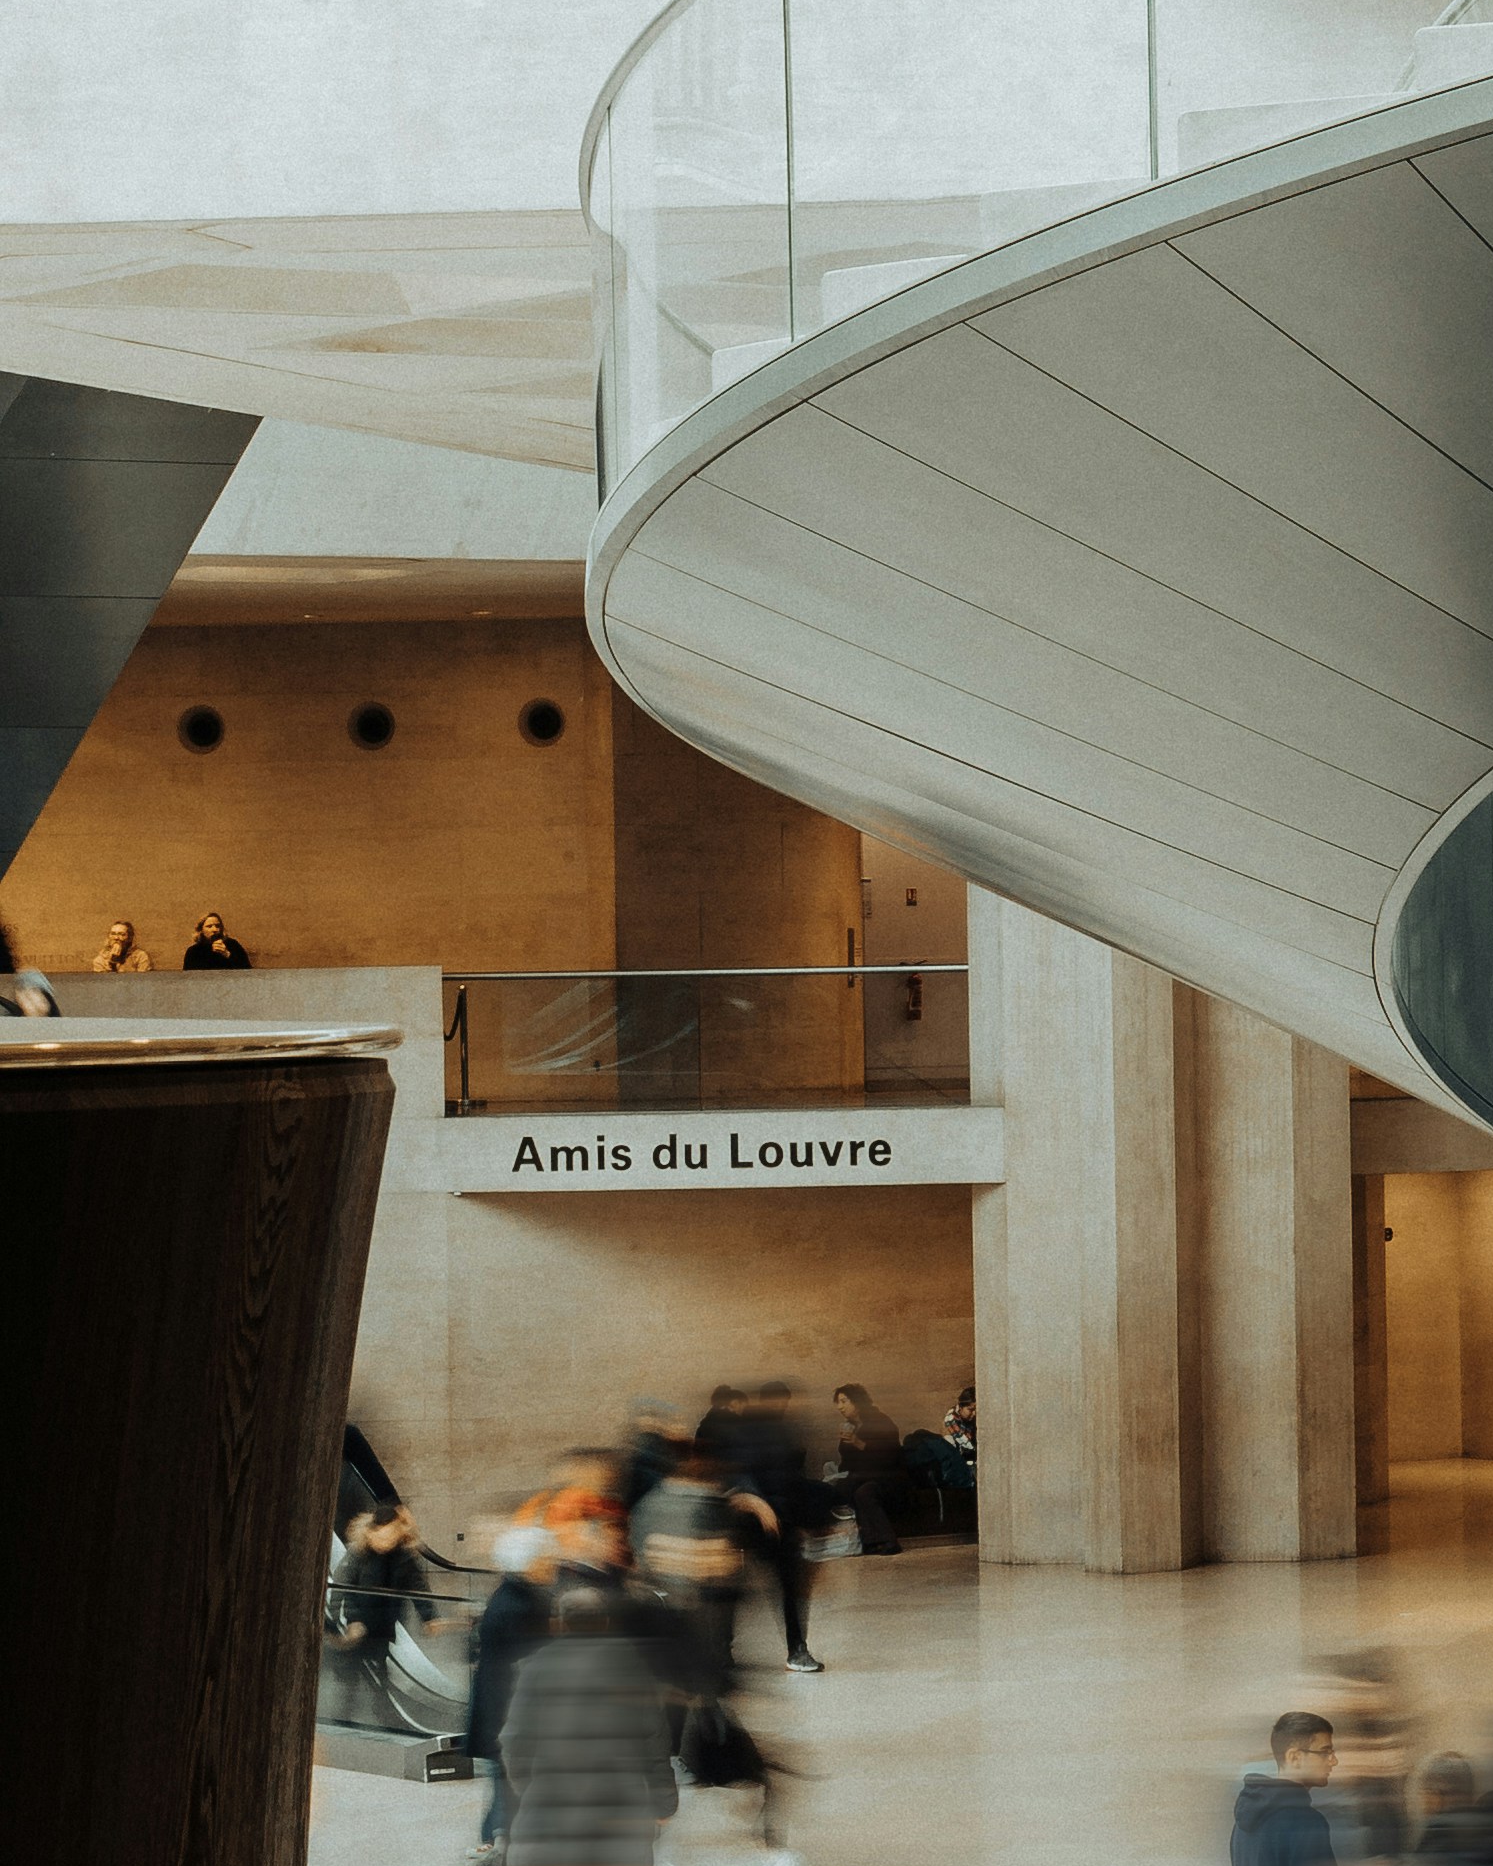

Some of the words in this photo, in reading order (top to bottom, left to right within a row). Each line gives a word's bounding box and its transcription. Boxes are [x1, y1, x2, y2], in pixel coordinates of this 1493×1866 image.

[511, 1134, 633, 1173] Amis
[652, 1133, 709, 1170] du
[729, 1133, 893, 1169] Louvre
